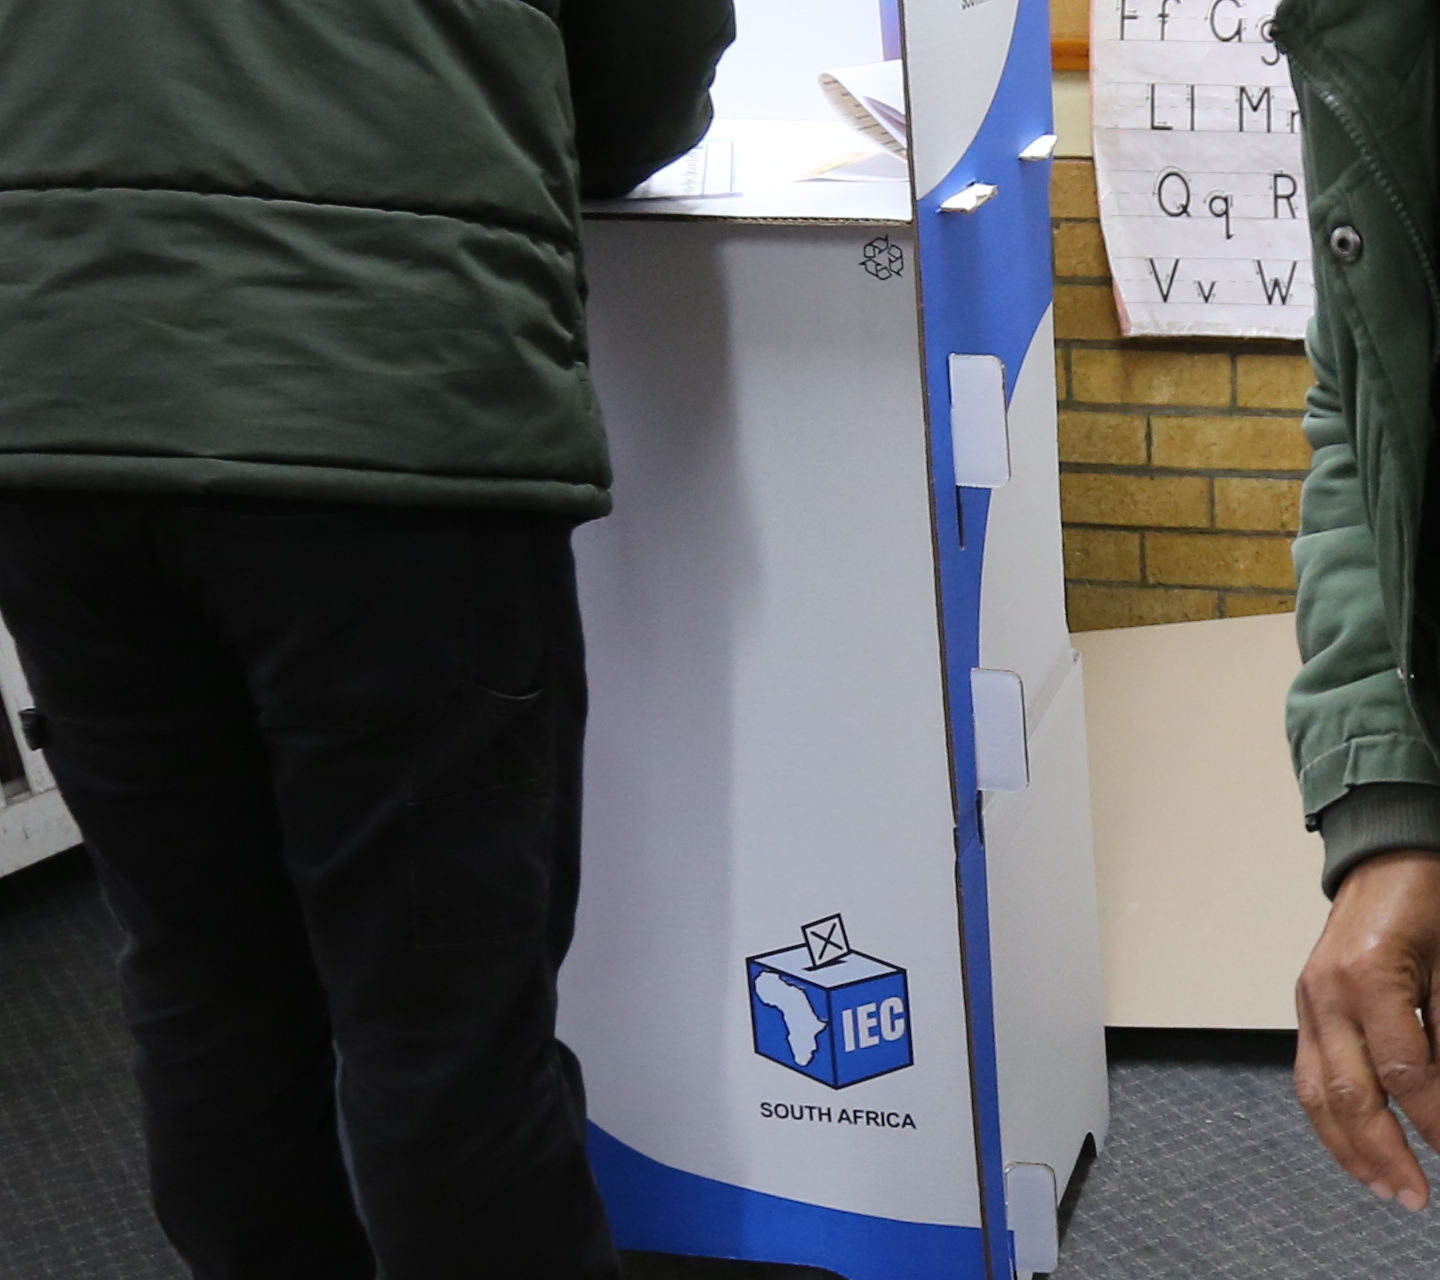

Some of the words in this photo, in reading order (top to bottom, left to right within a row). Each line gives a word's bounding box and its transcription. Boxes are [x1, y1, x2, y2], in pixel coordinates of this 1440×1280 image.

[842, 996, 905, 1053] IEC
[760, 1101, 832, 1124] SOUTH
[838, 1108, 917, 1129] AFRICA
